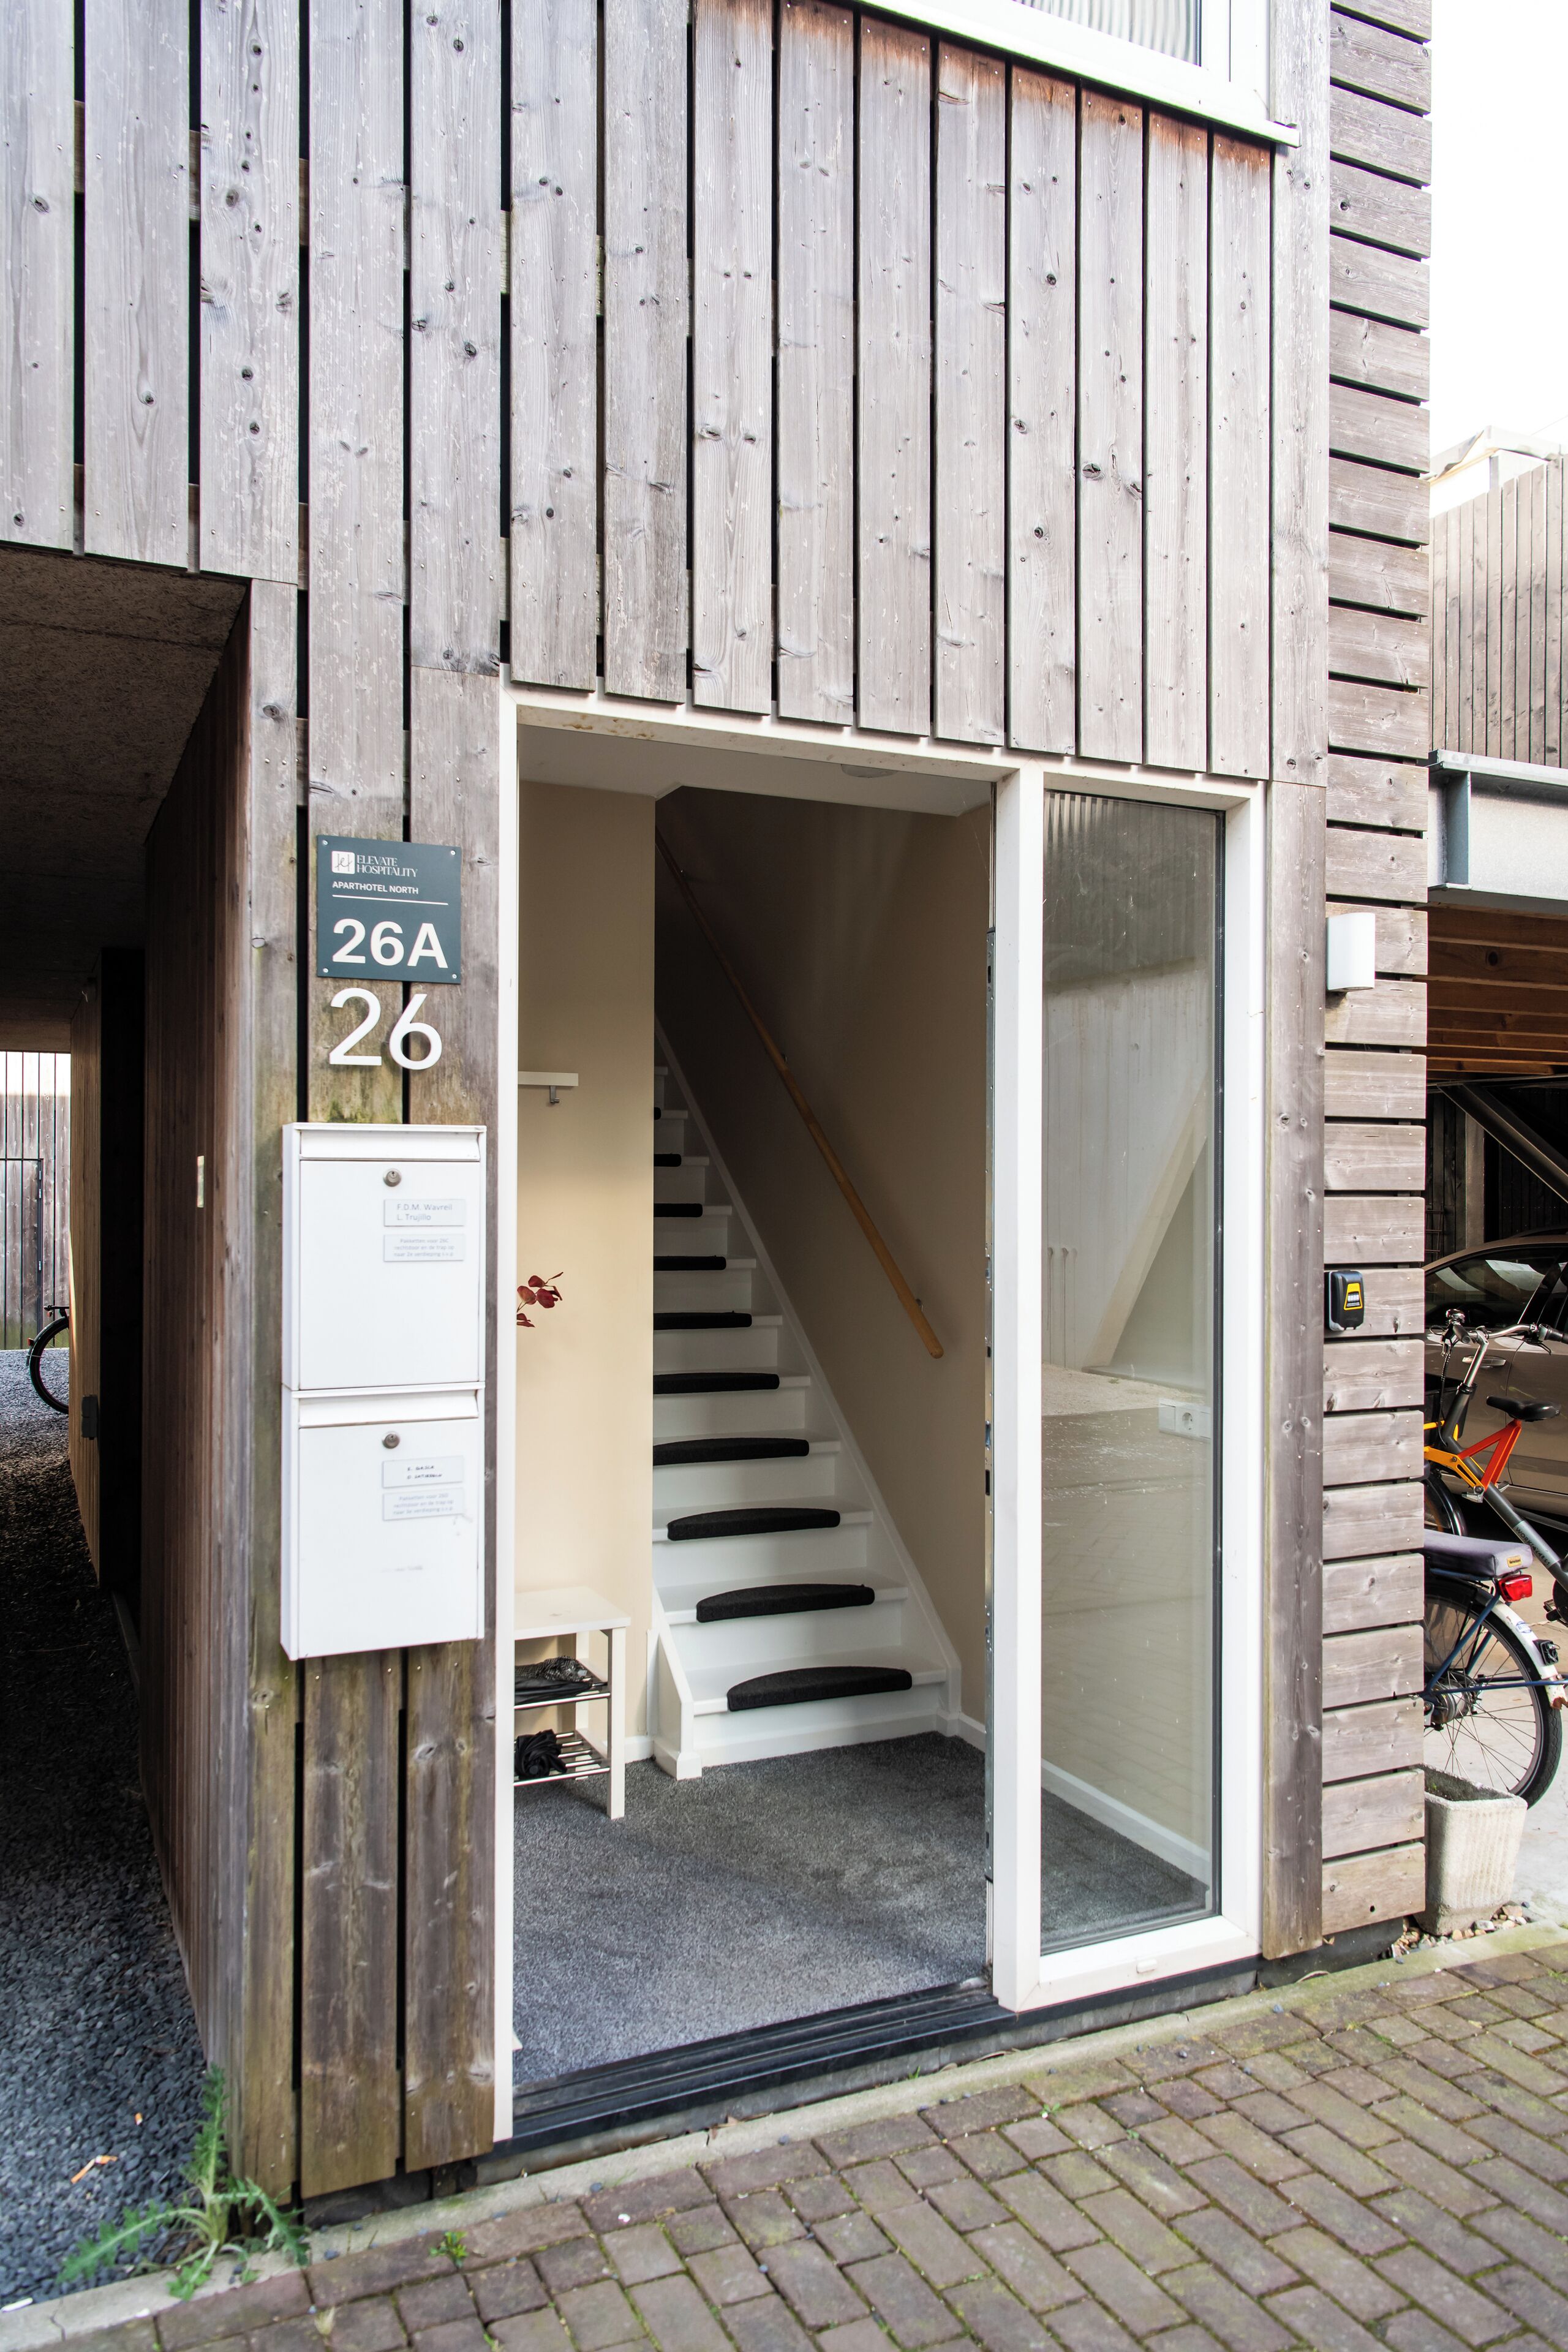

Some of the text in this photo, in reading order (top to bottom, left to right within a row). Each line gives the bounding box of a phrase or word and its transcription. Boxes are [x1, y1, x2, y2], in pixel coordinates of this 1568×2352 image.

[356, 854, 398, 867] ELEVATE
[356, 864, 418, 877] HOSPITALITY
[332, 881, 419, 894] APARTHOTEL NORTH
[332, 918, 448, 968] 26A
[329, 987, 442, 1070] 26
